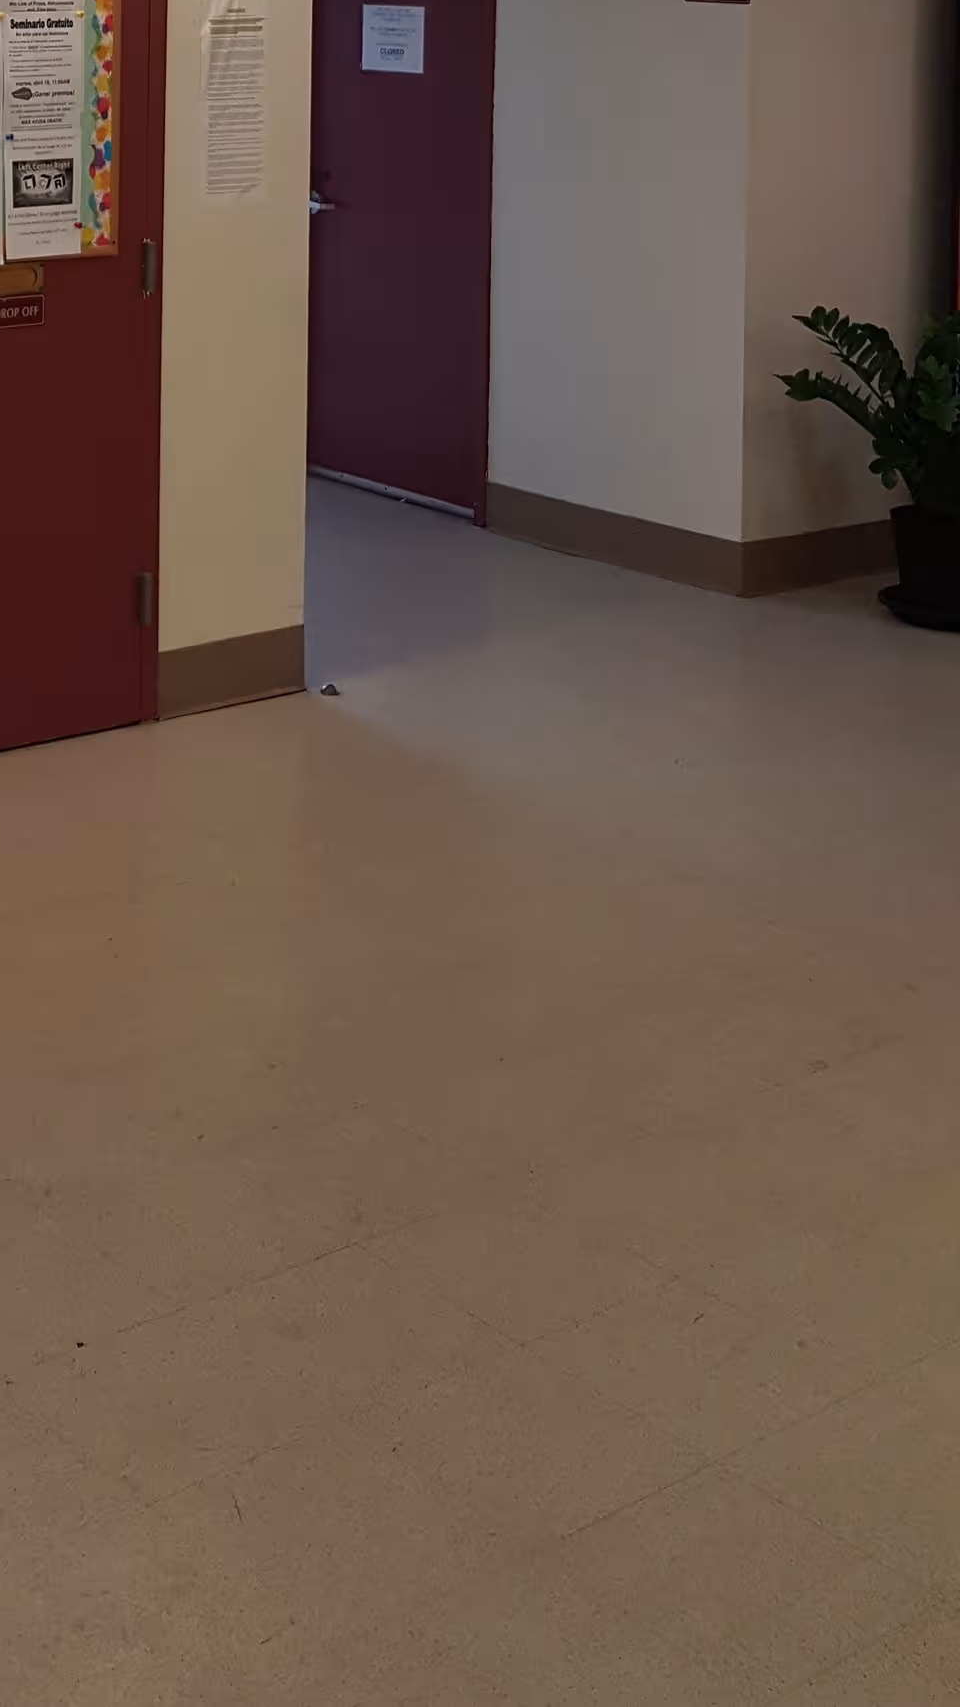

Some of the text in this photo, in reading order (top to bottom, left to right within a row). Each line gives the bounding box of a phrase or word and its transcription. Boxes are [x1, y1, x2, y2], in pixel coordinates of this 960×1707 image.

[10, 18, 74, 30] Seminario Gratuito
[380, 47, 405, 55] CLOSED
[18, 161, 70, 172] Left Center Right
[21, 305, 39, 317] OFF
